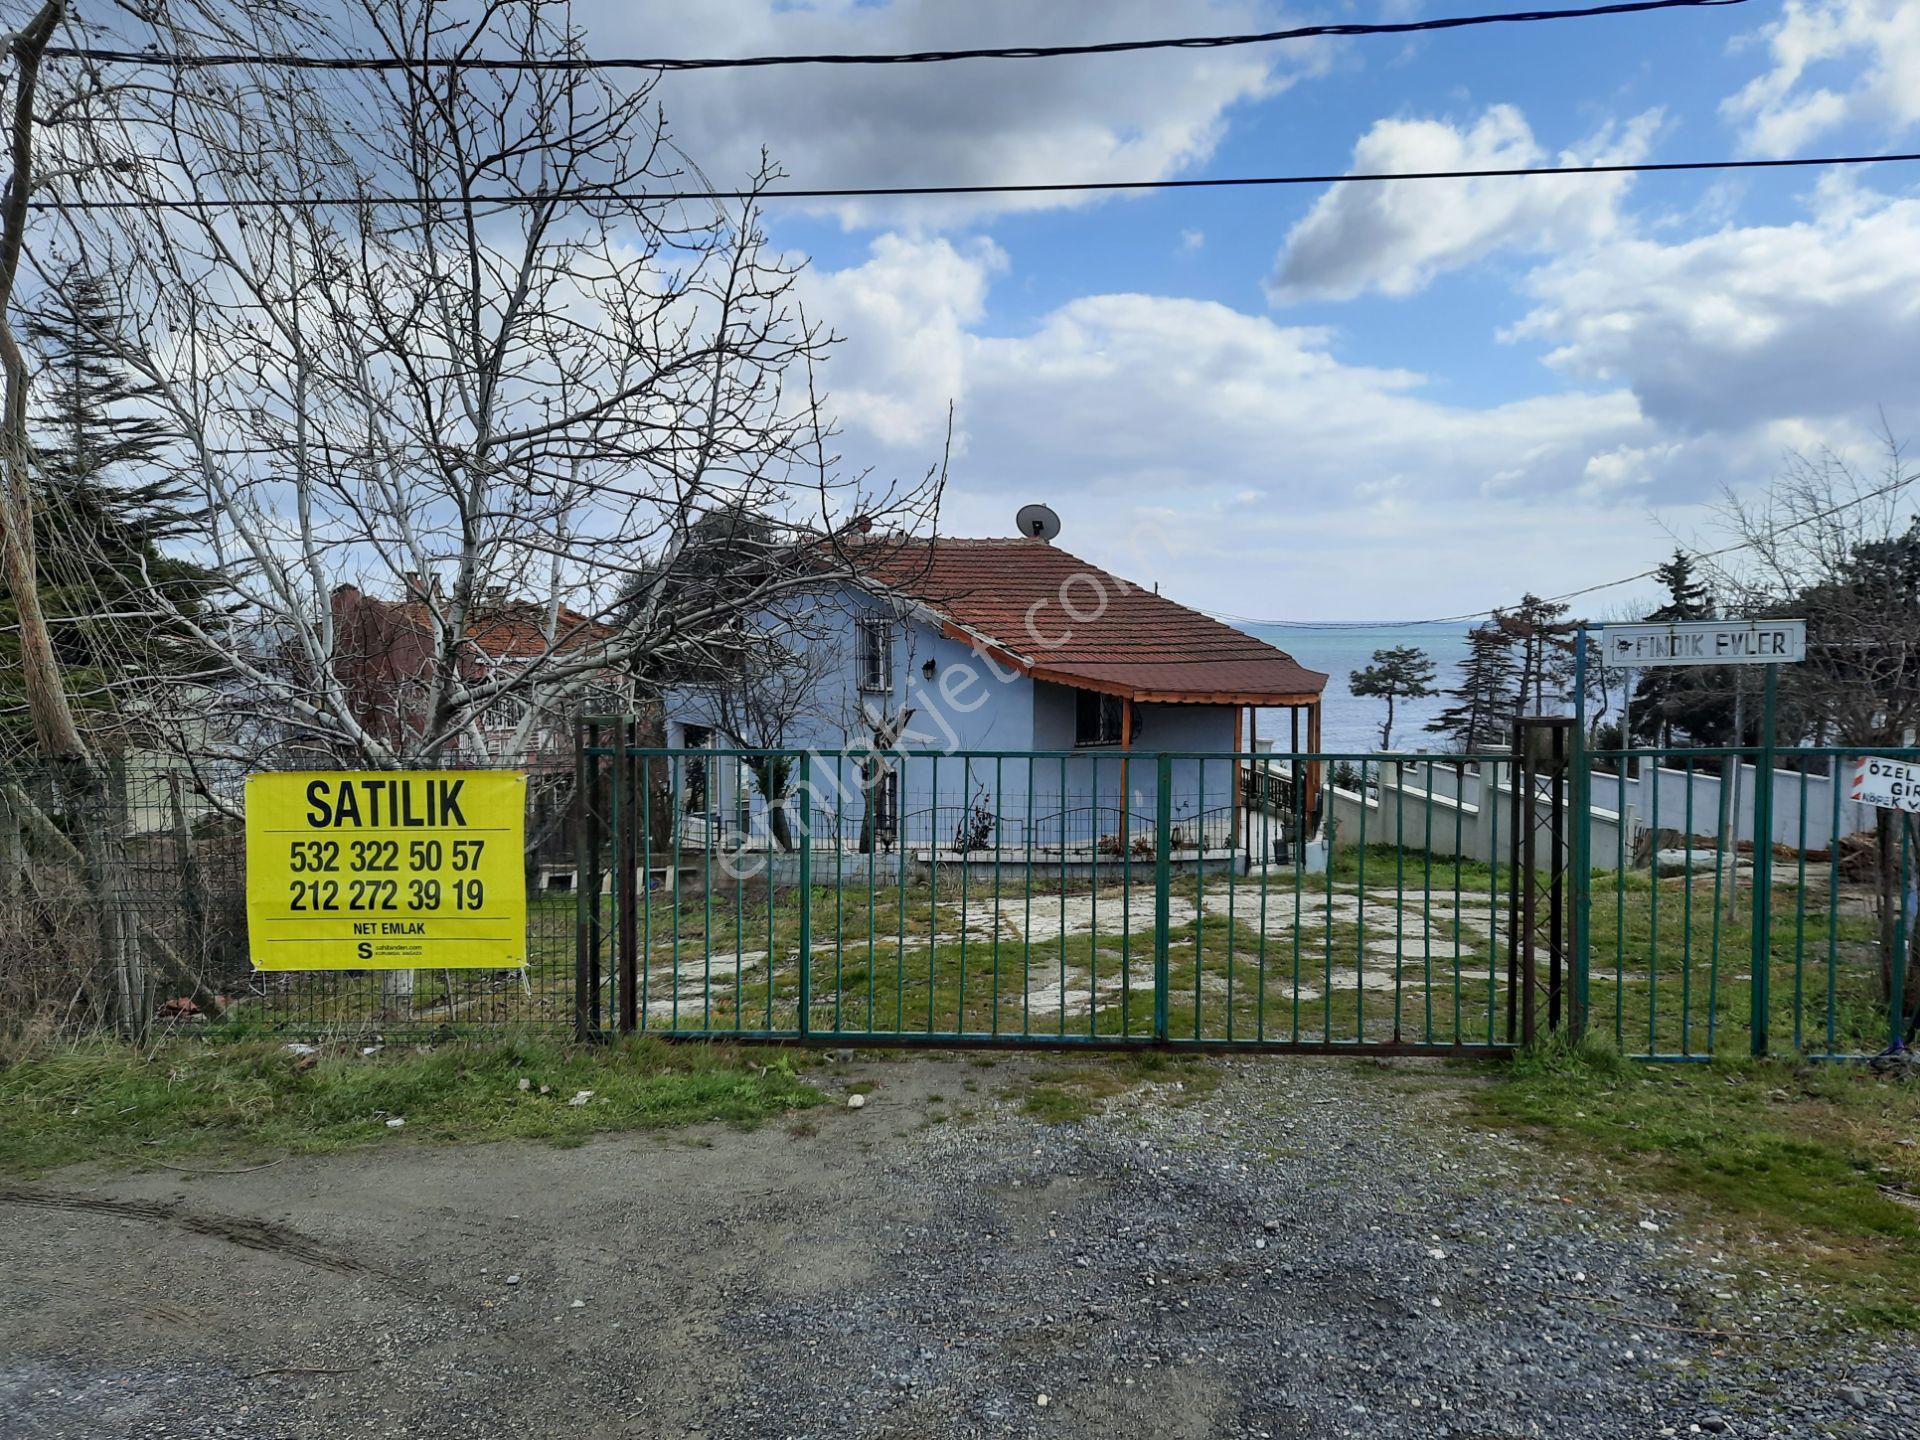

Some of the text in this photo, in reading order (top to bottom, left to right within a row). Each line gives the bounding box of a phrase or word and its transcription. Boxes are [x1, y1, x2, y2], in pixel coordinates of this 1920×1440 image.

[1636, 632, 1785, 657] FINDIK EVLER
[1869, 760, 1915, 782] ÖZEL
[306, 779, 467, 828] SATILIK
[290, 840, 485, 872] 532 322 50 57
[289, 879, 484, 911] 212 272 39 19
[353, 922, 425, 935] NET EMLAK
